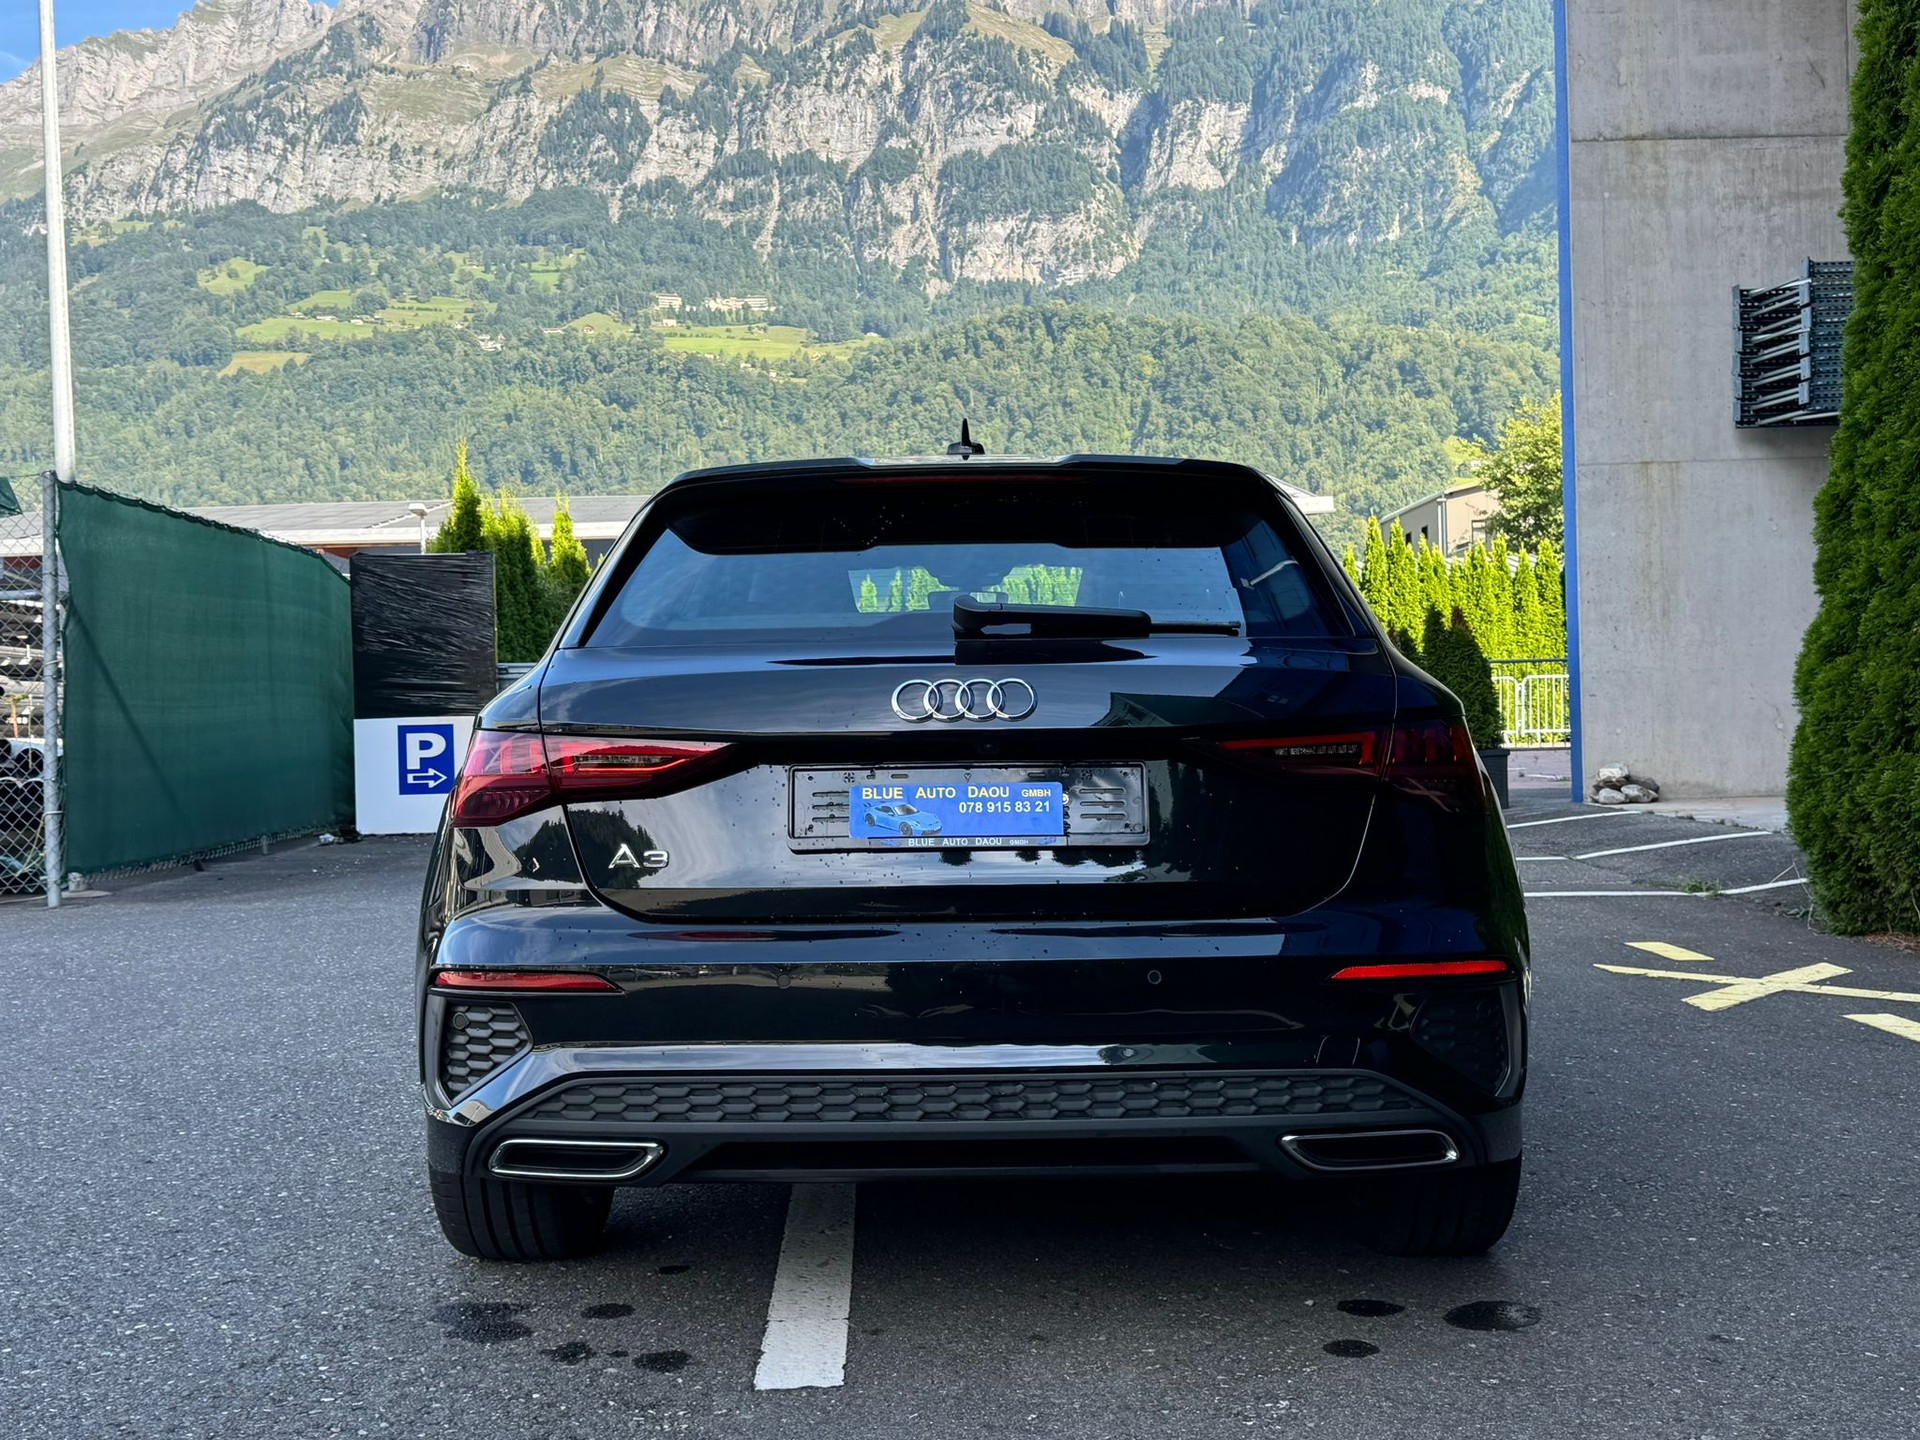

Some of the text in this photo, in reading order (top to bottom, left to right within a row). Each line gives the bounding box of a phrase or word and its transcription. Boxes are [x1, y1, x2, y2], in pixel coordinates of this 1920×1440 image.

[406, 733, 446, 770] P
[862, 786, 1051, 799] BLUE AUTO DAOU GMBH
[959, 800, 1050, 813] 078 915 83 21
[908, 838, 935, 846] BLUE
[942, 838, 968, 846] AUTO
[608, 843, 668, 869] A3
